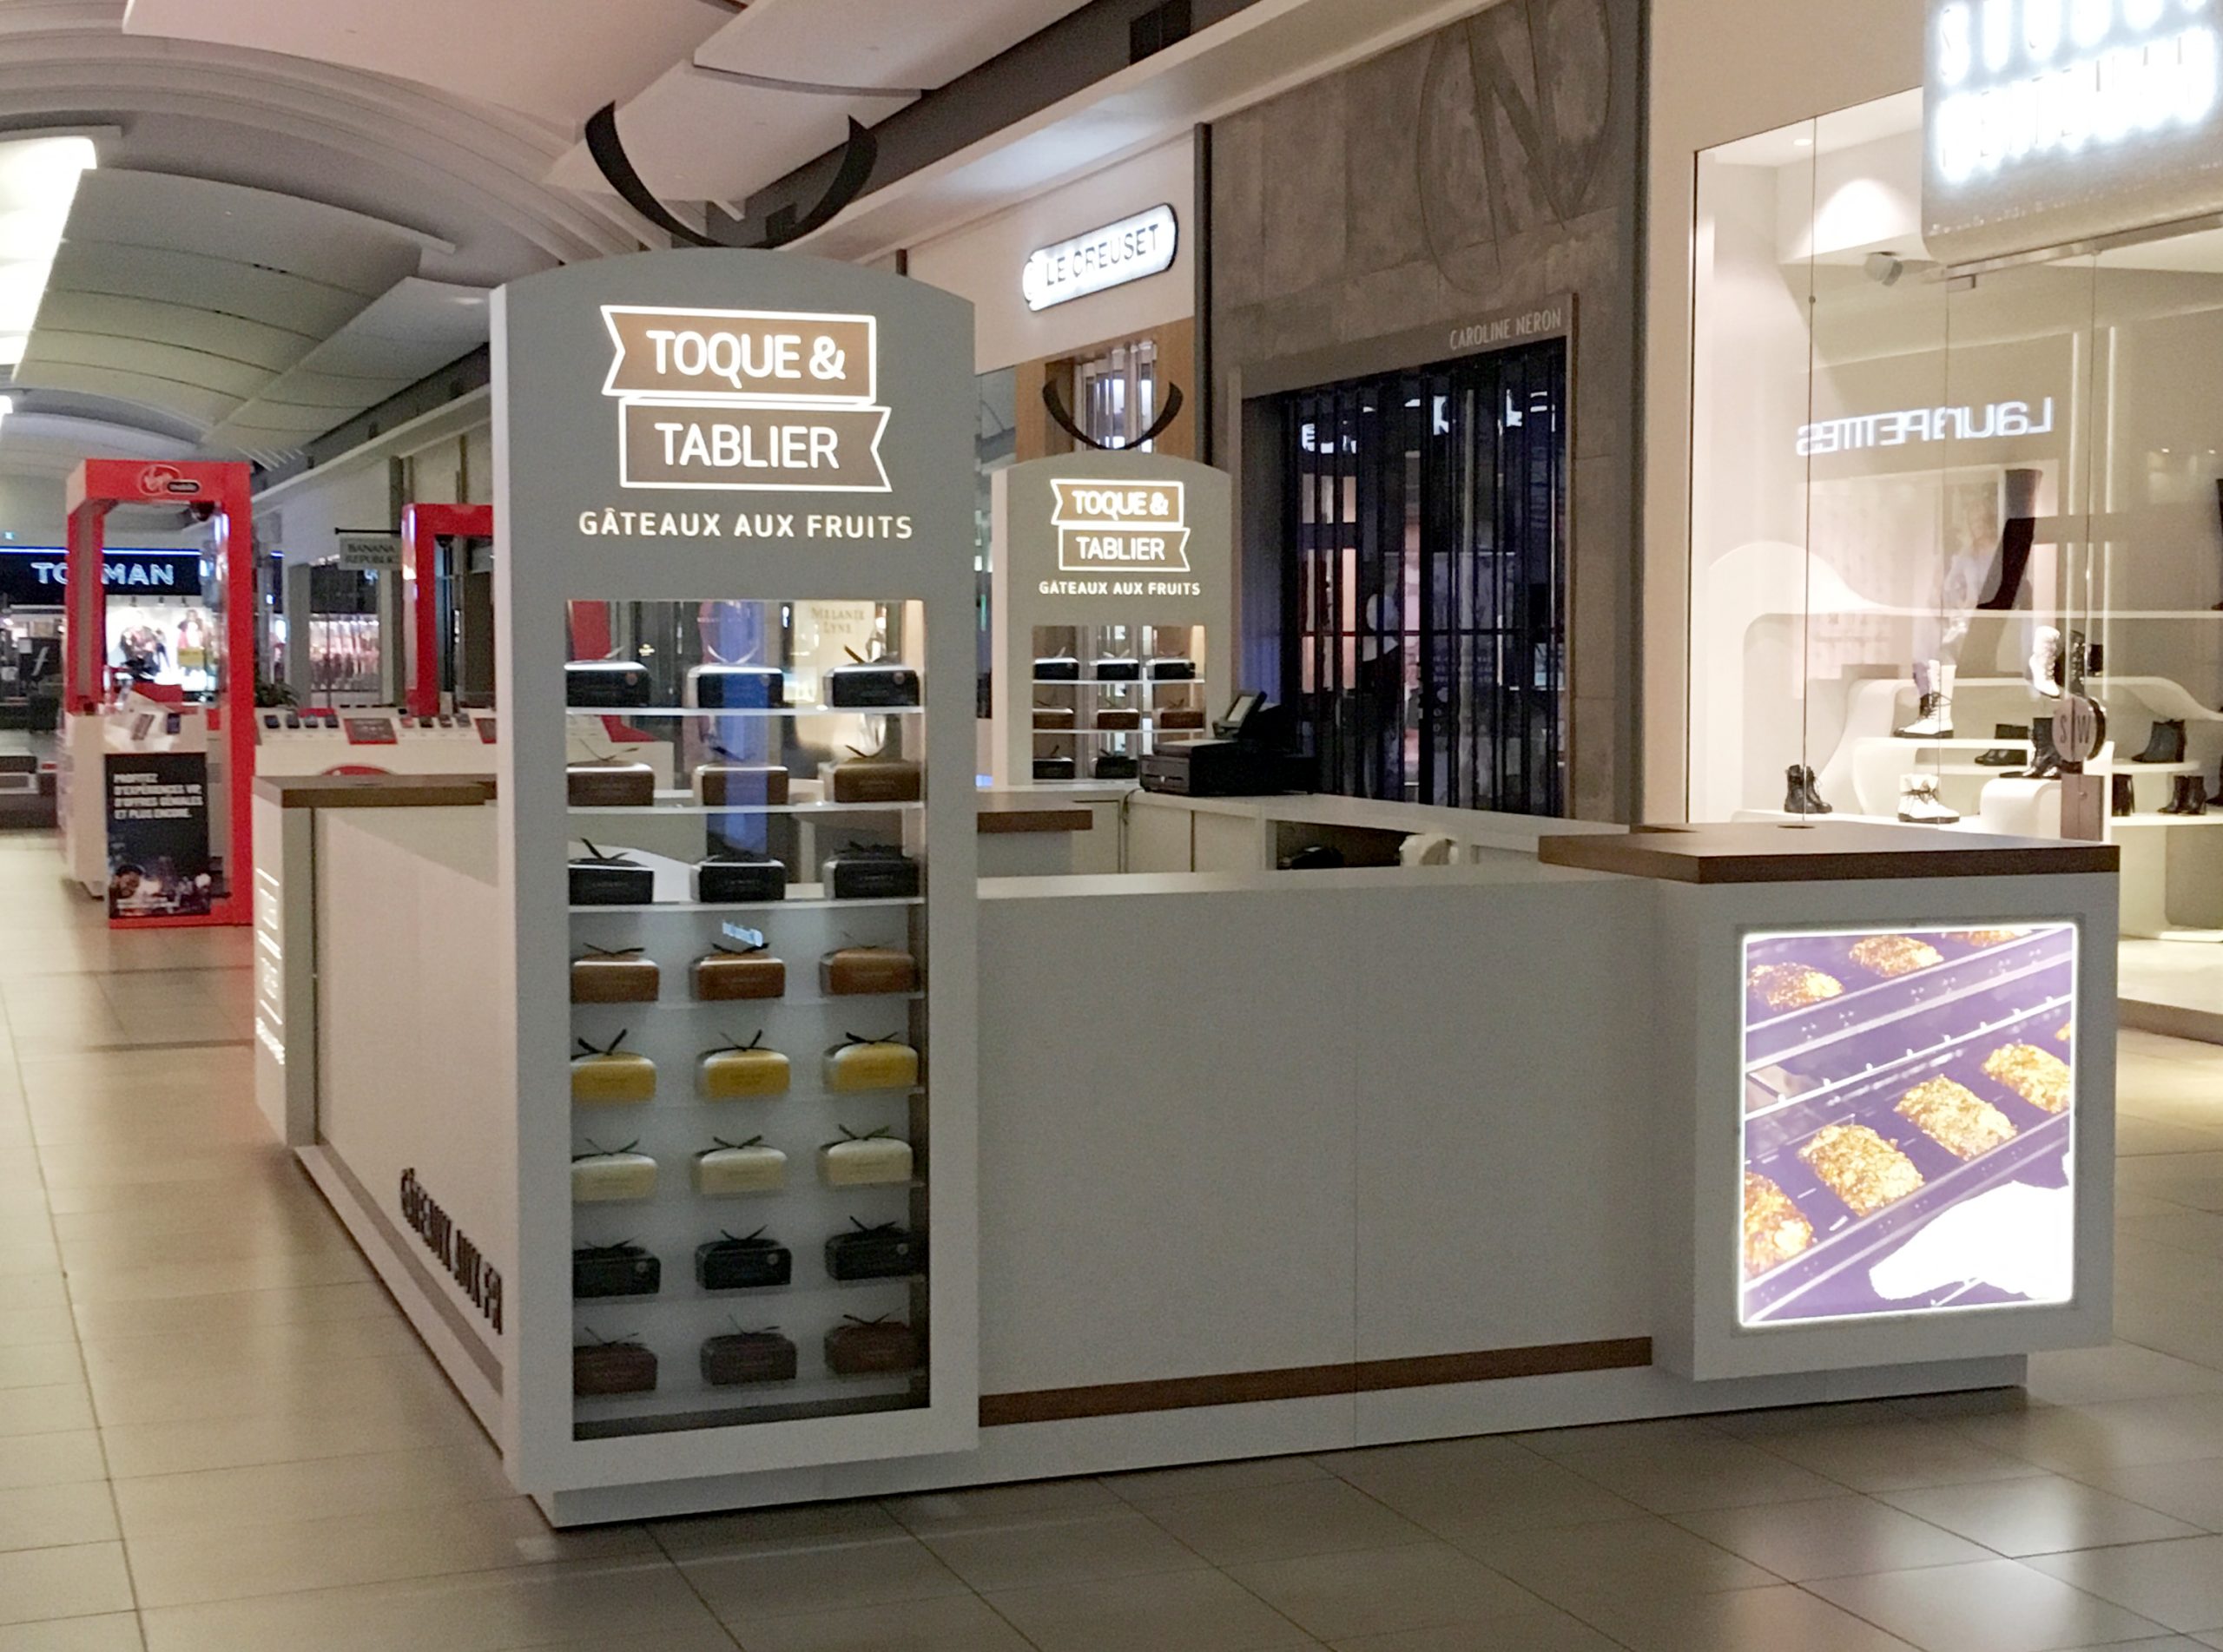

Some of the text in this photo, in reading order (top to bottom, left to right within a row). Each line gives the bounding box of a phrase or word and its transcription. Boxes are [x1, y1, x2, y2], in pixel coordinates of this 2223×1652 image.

[1046, 223, 1159, 286] LE CREUSET
[1449, 307, 1562, 350] CAROLINE NERON
[646, 329, 847, 389] TOQUE &
[654, 422, 840, 470] TABLIER
[1072, 490, 1169, 521] TOQUE &
[578, 507, 914, 540] GÂTEAUX AUX FRUITS
[1075, 536, 1165, 561] TABLIER
[30, 562, 175, 586] TOMAN
[1113, 582, 1144, 596] AUX
[1148, 582, 1201, 596] FRUITS
